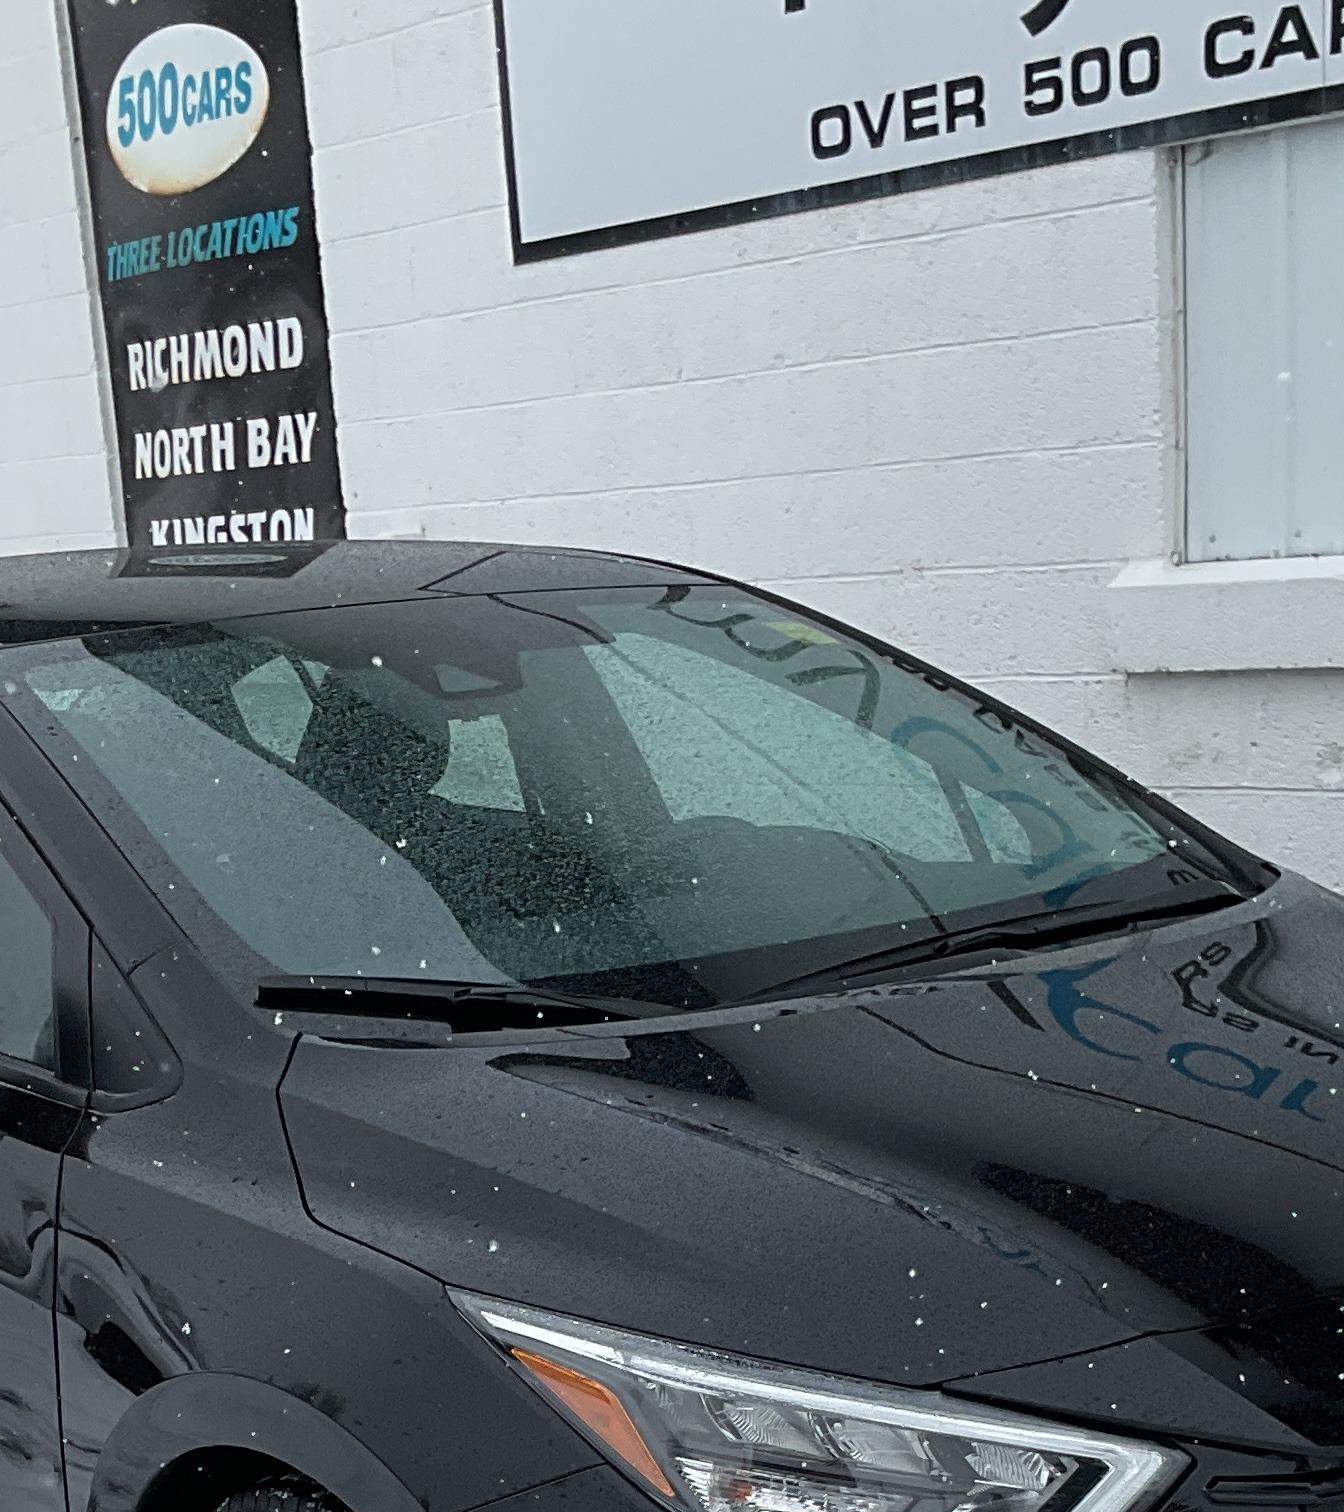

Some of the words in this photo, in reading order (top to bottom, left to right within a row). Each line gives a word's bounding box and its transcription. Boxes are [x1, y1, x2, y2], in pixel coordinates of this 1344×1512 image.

[810, 75, 985, 160] OVER
[1023, 35, 1160, 117] 500
[107, 234, 162, 281] THREE
[167, 206, 300, 268] LOCATIONS
[127, 316, 304, 391] RICHMOND
[134, 421, 235, 479] NORTH
[246, 411, 317, 468] BAY
[150, 507, 314, 546] KINGSTON
